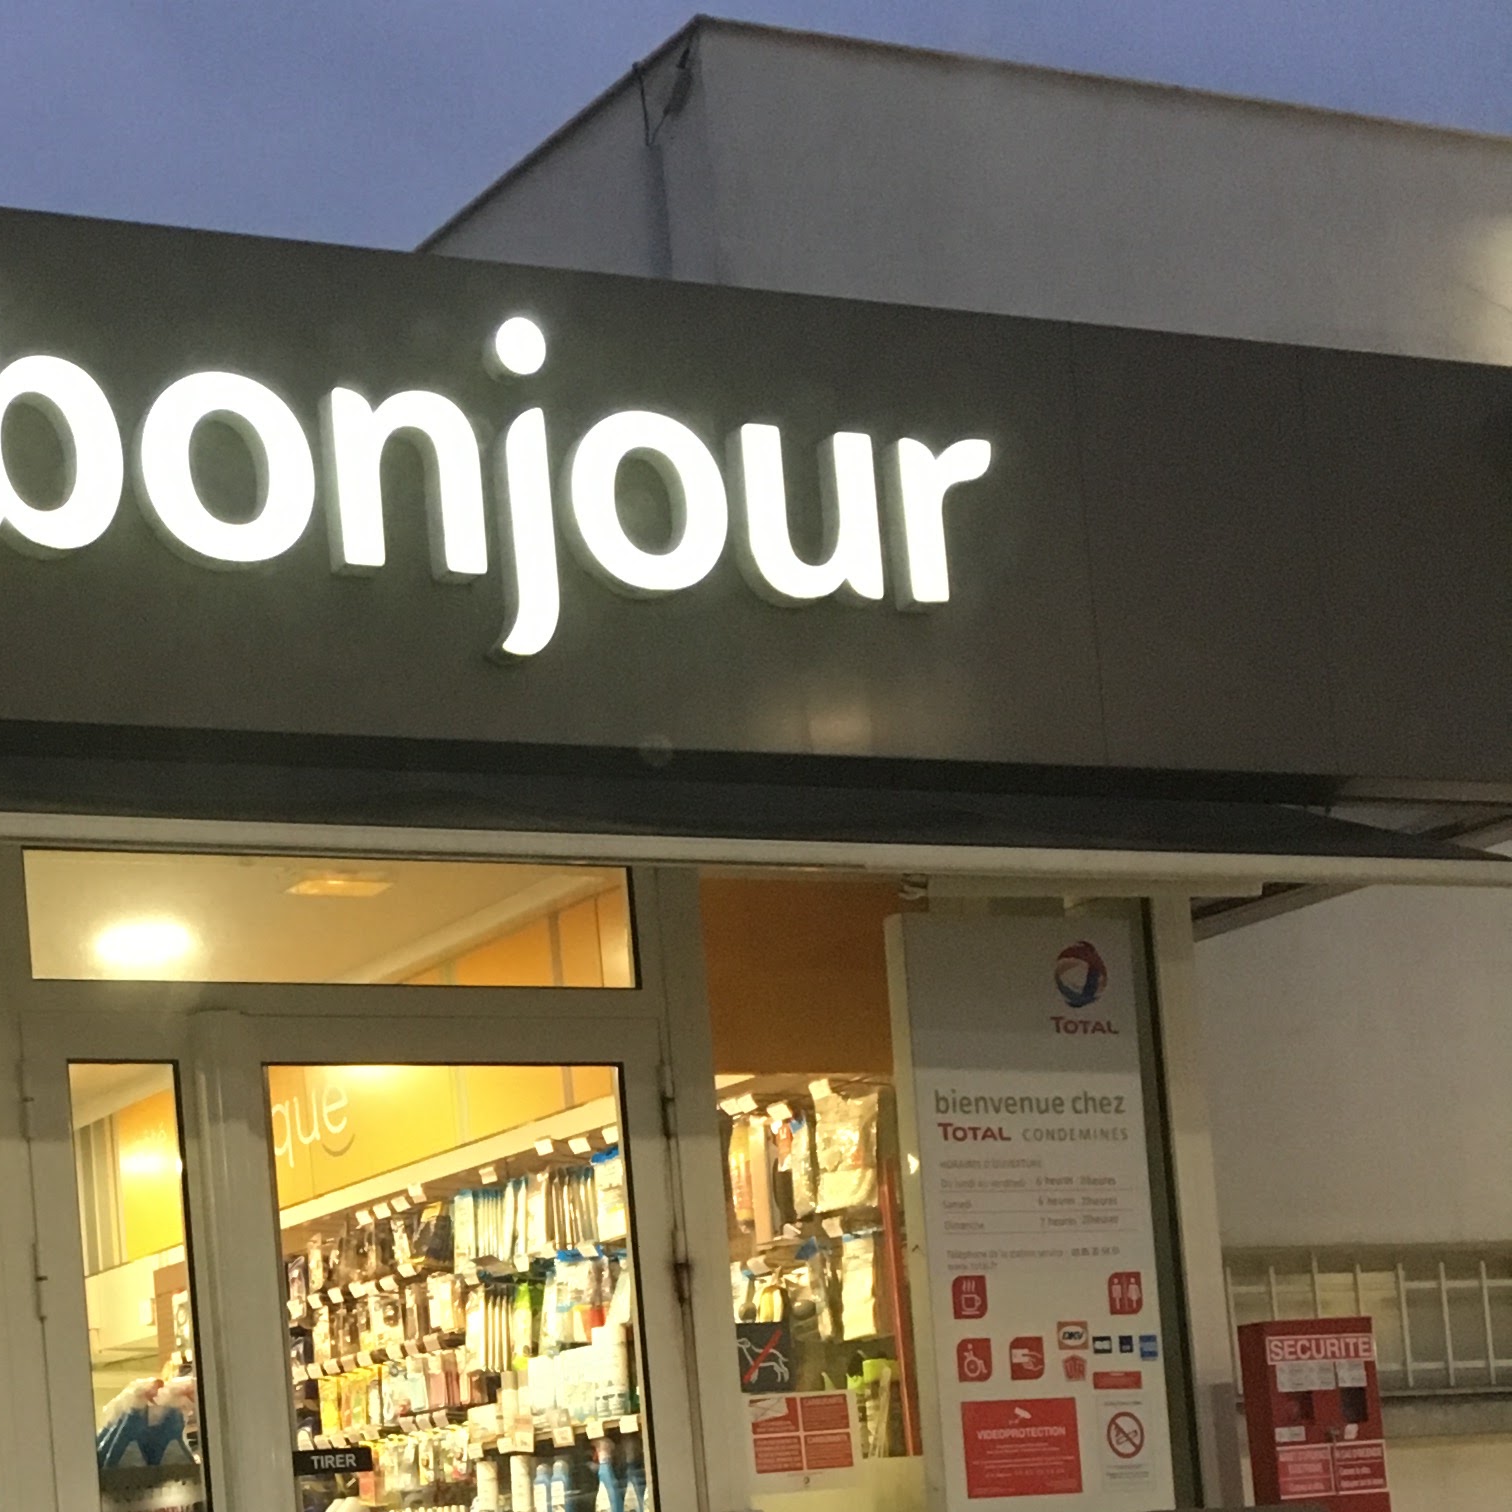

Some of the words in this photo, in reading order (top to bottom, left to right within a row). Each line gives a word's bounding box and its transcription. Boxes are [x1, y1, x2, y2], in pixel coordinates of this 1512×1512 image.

[1050, 1016, 1120, 1035] TOTAL
[934, 1089, 1065, 1115] bienvenue
[1072, 1090, 1126, 1114] chez
[937, 1122, 1012, 1142] TOTAL
[1022, 1127, 1129, 1143] CONDEMINES
[1270, 1337, 1372, 1360] SECURITE
[976, 1426, 1066, 1440] VIDEOPROTECTION
[310, 1453, 357, 1470] TIRER
